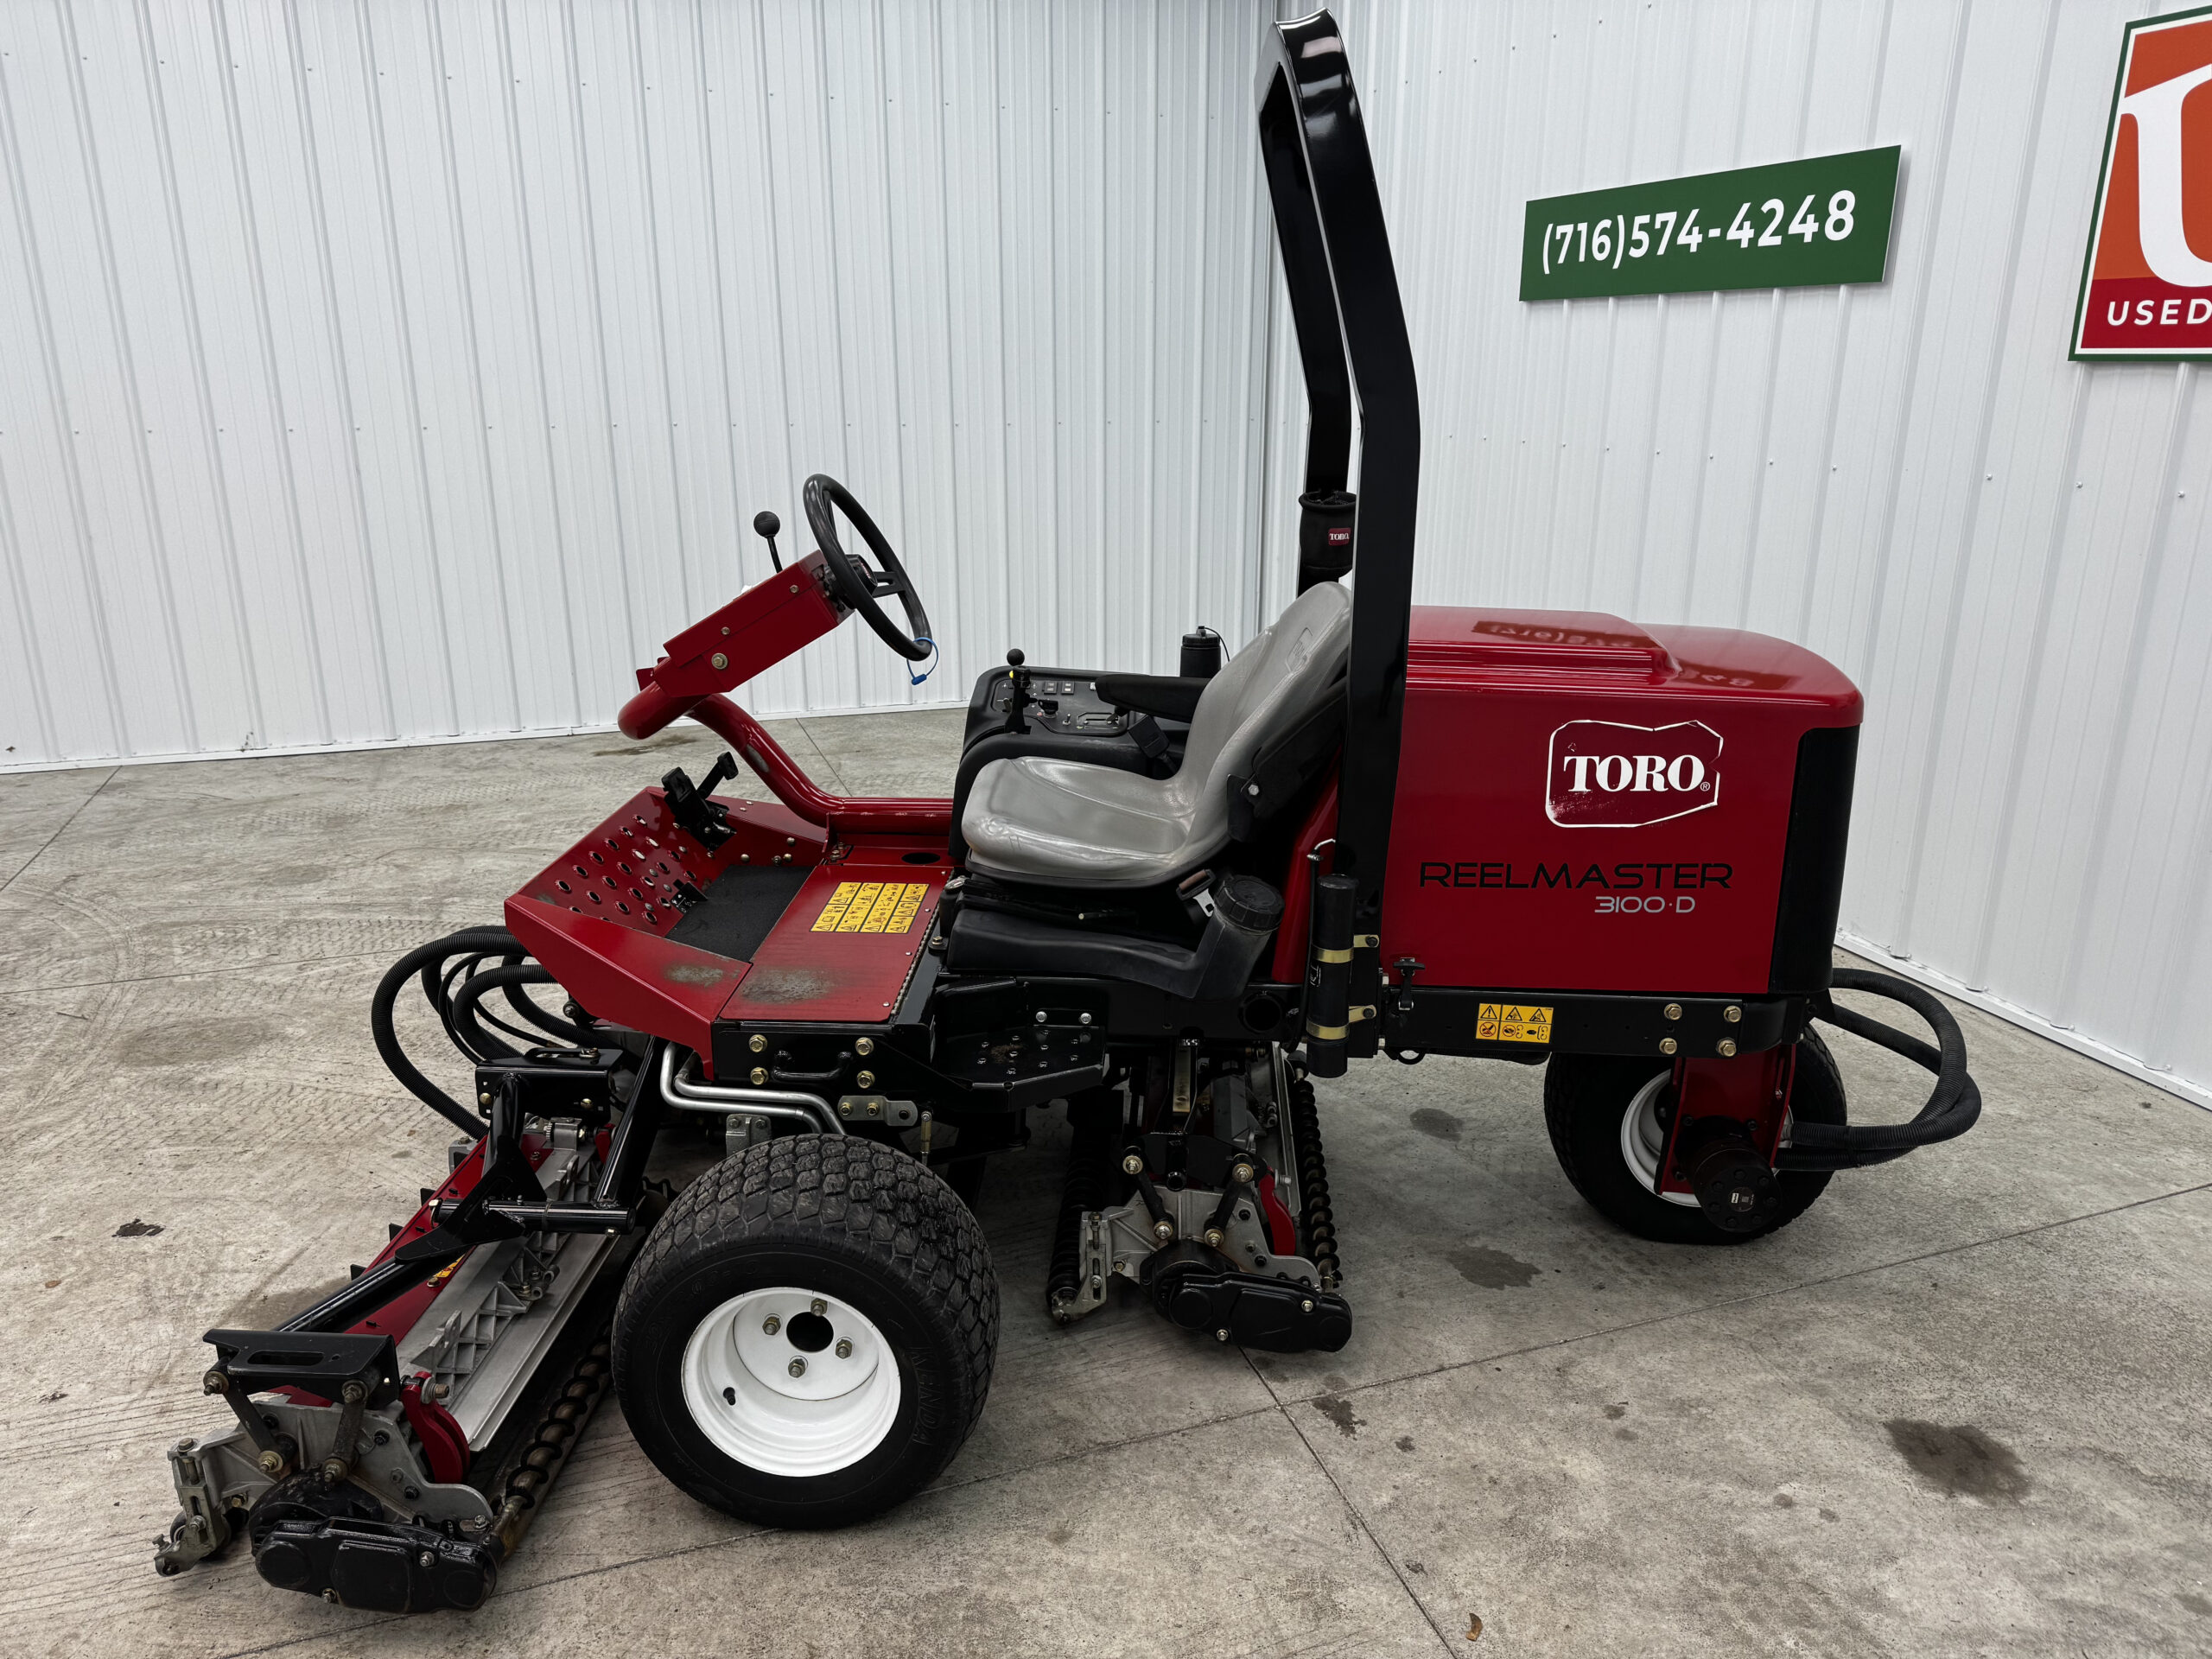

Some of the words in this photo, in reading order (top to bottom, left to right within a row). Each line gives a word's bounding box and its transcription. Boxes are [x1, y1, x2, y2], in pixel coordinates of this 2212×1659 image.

[1542, 189, 1856, 275] (716)574-4248
[2107, 298, 2212, 327] USED
[1563, 753, 1705, 792] TORO
[1420, 862, 1733, 889] REELMASTER
